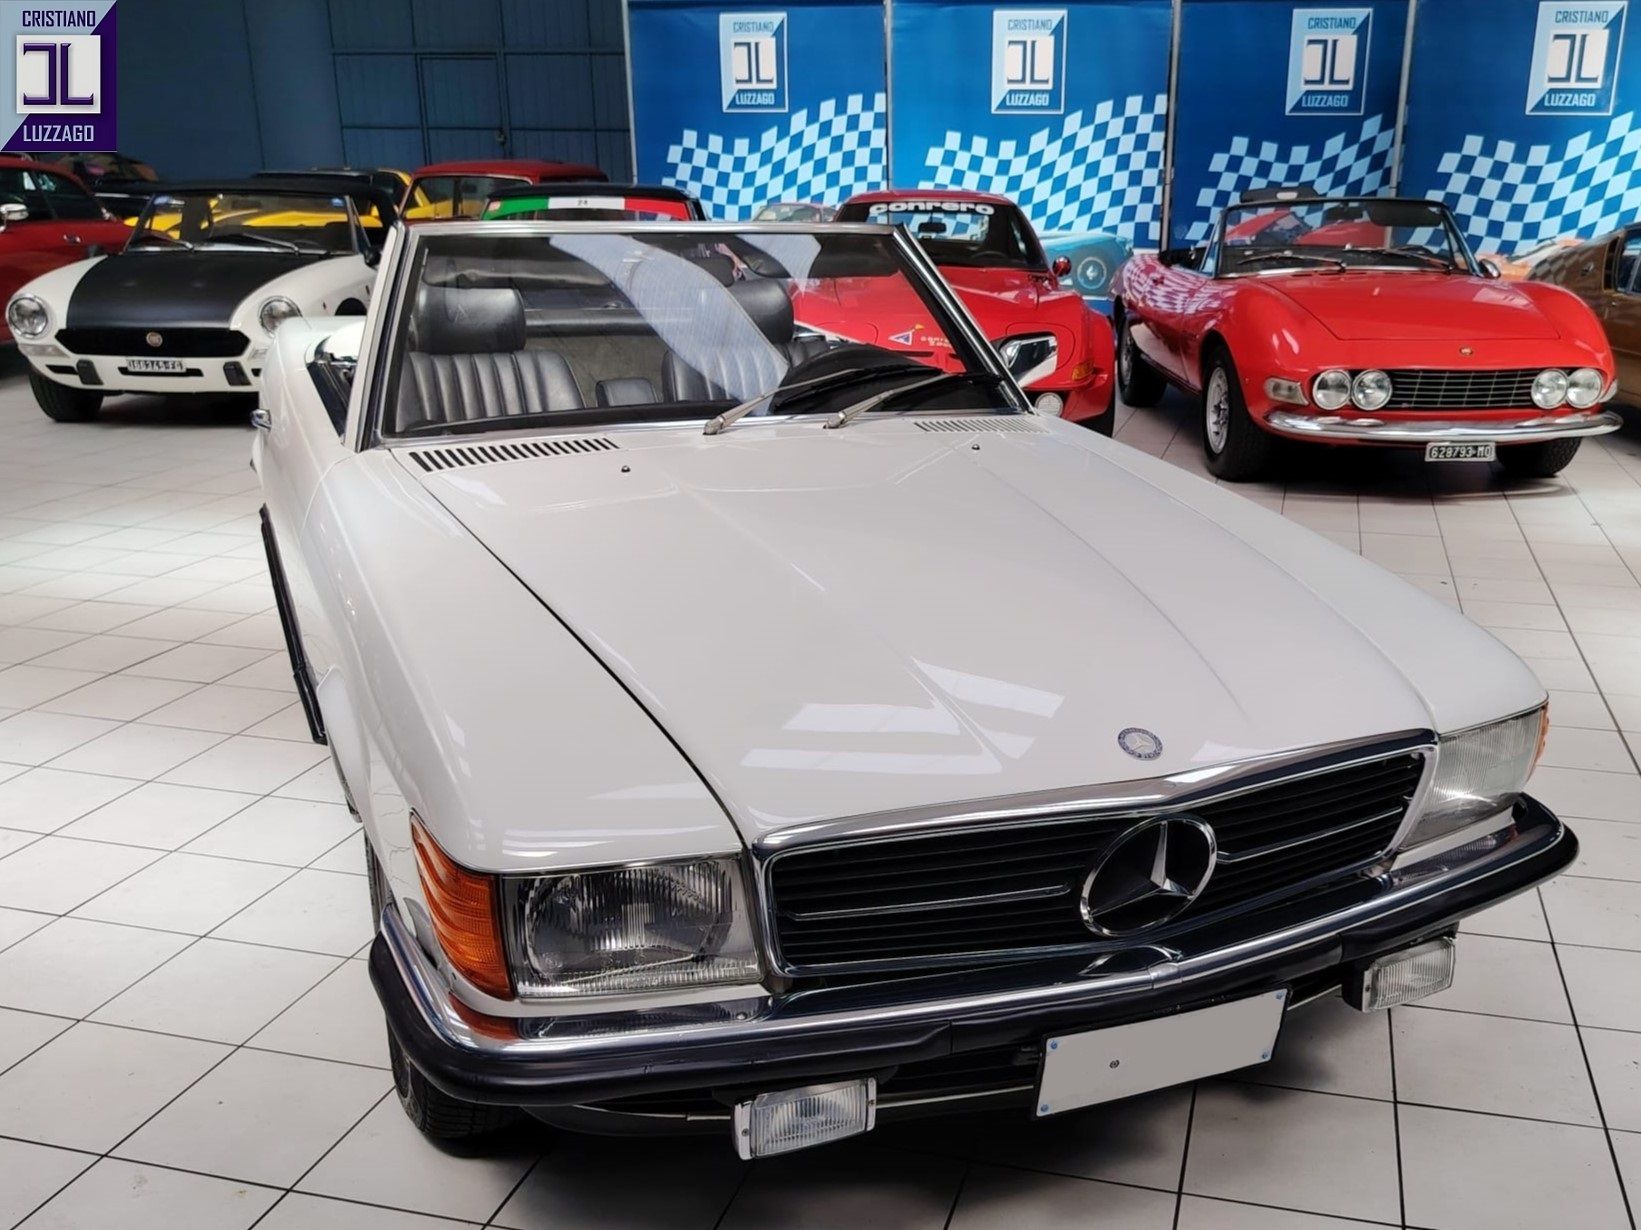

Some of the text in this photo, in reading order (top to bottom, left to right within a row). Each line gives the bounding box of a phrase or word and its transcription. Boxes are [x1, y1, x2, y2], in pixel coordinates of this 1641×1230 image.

[1307, 17, 1357, 29] CRISTIANO
[1555, 10, 1609, 23] CRISTIANO
[732, 21, 774, 33] CRISTIANO
[1007, 19, 1052, 31] CRISTIANO
[735, 92, 775, 105] LUZZAGO
[1006, 92, 1049, 106] LUZZAGO
[1301, 94, 1349, 107] LUZZAGO
[1543, 93, 1596, 107] LUZZAGO
